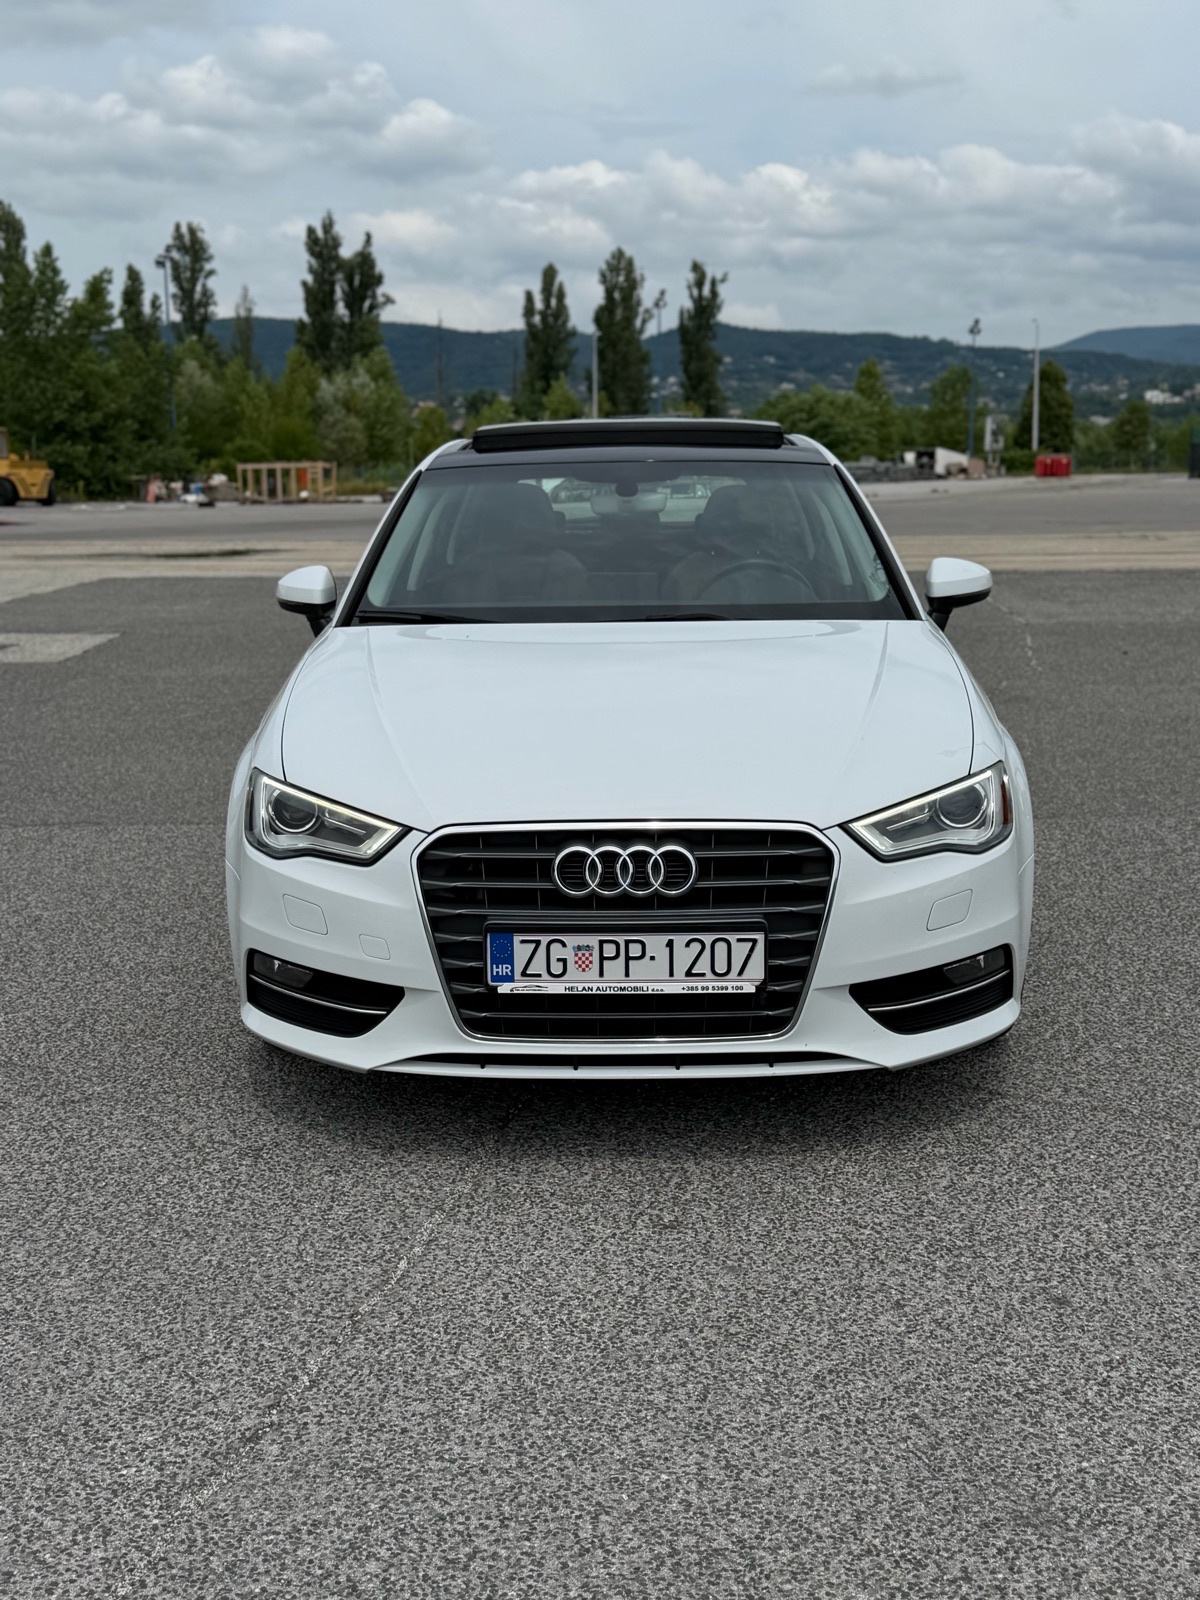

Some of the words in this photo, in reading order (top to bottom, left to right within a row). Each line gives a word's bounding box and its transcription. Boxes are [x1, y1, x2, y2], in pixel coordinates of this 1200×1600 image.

[519, 938, 568, 978] ZG
[493, 964, 511, 976] HR
[564, 985, 595, 993] HELAN
[597, 985, 649, 993] AUTOMOBILI
